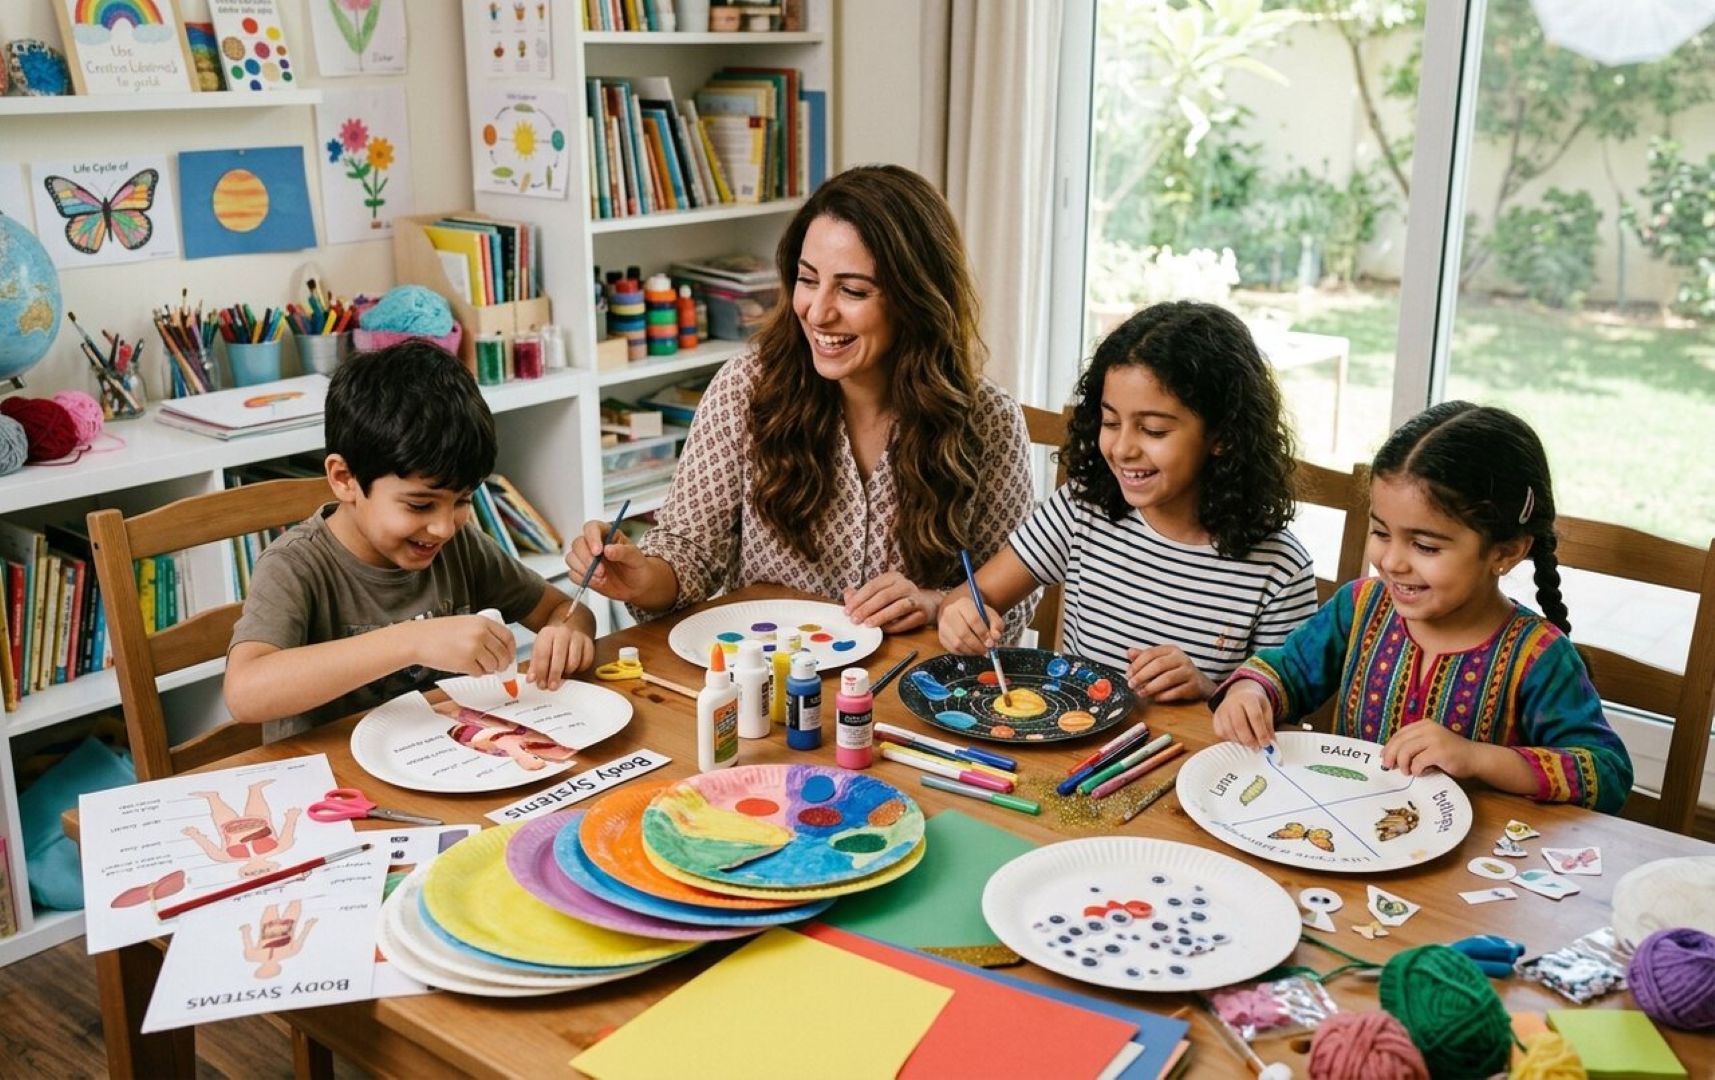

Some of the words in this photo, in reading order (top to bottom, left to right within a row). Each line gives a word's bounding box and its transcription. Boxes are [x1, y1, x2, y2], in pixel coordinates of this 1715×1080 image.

[595, 756, 653, 781] Body
[186, 985, 283, 1010] SYSTEMS
[290, 978, 350, 995] BODY
